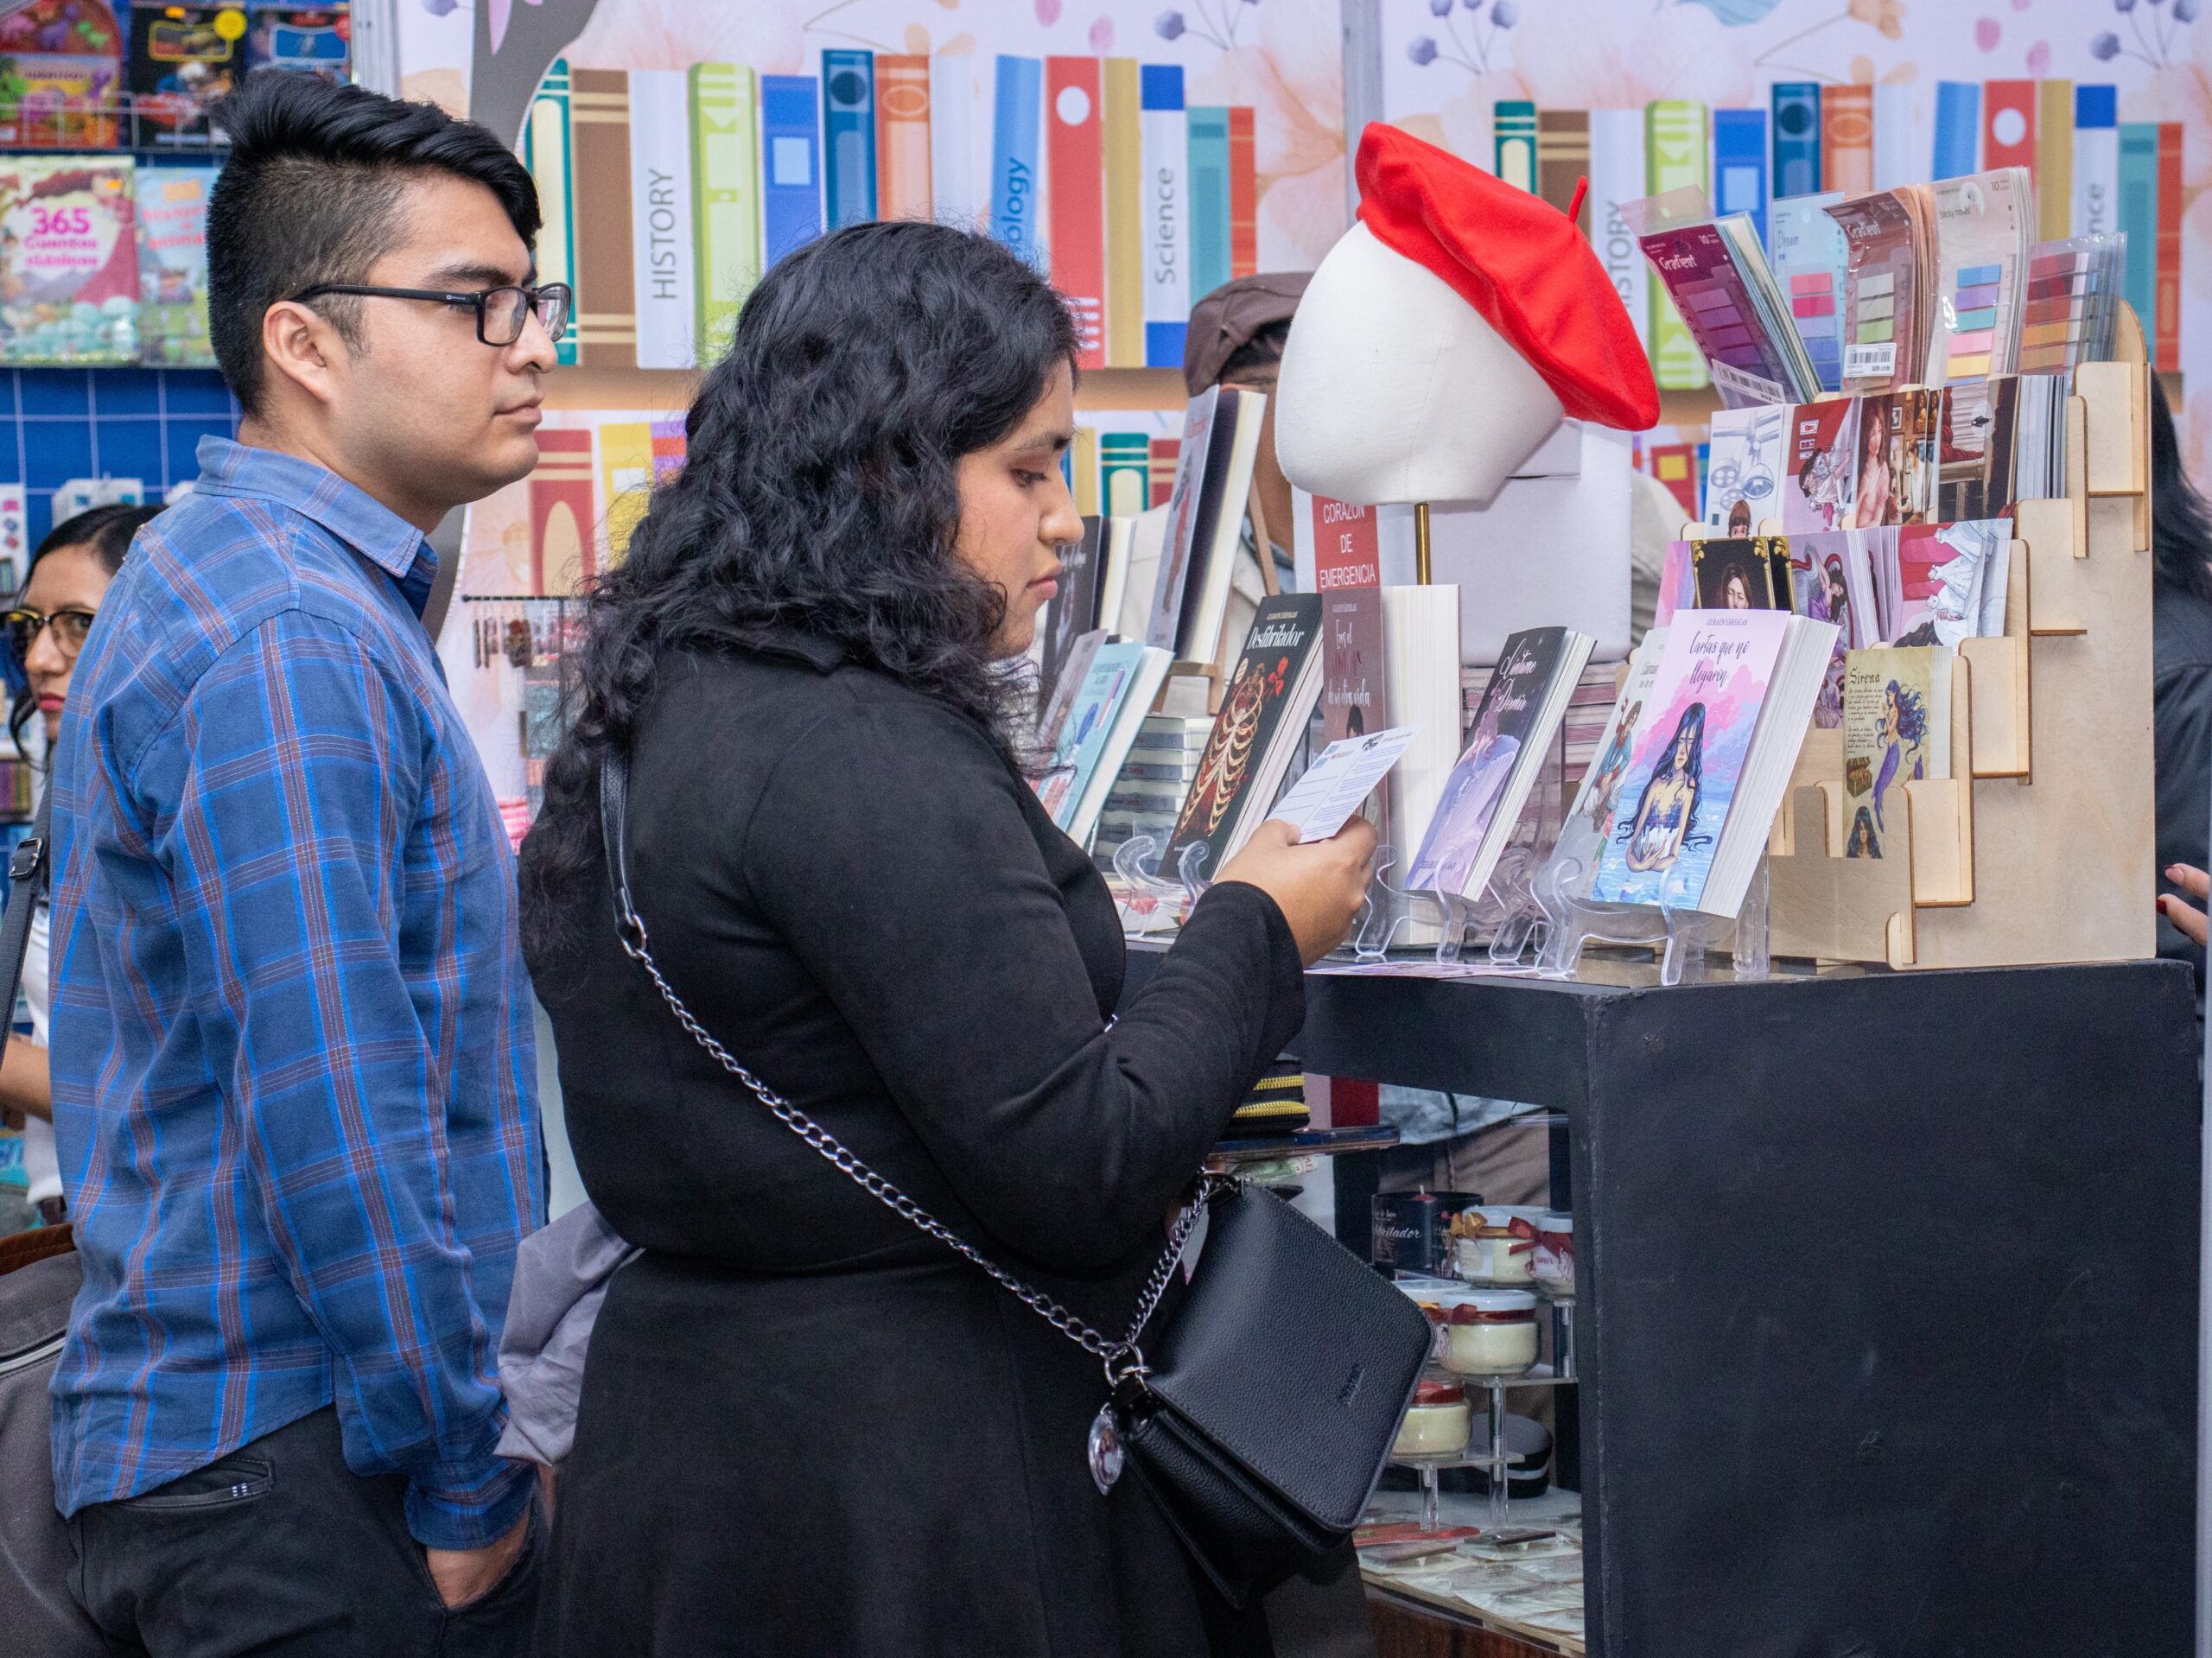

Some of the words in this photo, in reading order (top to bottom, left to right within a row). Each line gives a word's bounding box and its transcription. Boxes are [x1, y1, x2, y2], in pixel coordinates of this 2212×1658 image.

[1001, 157, 1031, 251] ology
[31, 206, 89, 235] 365
[648, 168, 677, 299] HISTORY
[1154, 168, 1176, 284] Science
[1659, 254, 1697, 270] Gradient
[1340, 533, 1353, 554] DE
[1319, 563, 1376, 588] EMERGENCIA
[1246, 622, 1305, 650] Desfibrilador
[1689, 631, 1718, 654] Cartas
[1850, 666, 1880, 684] Sirena
